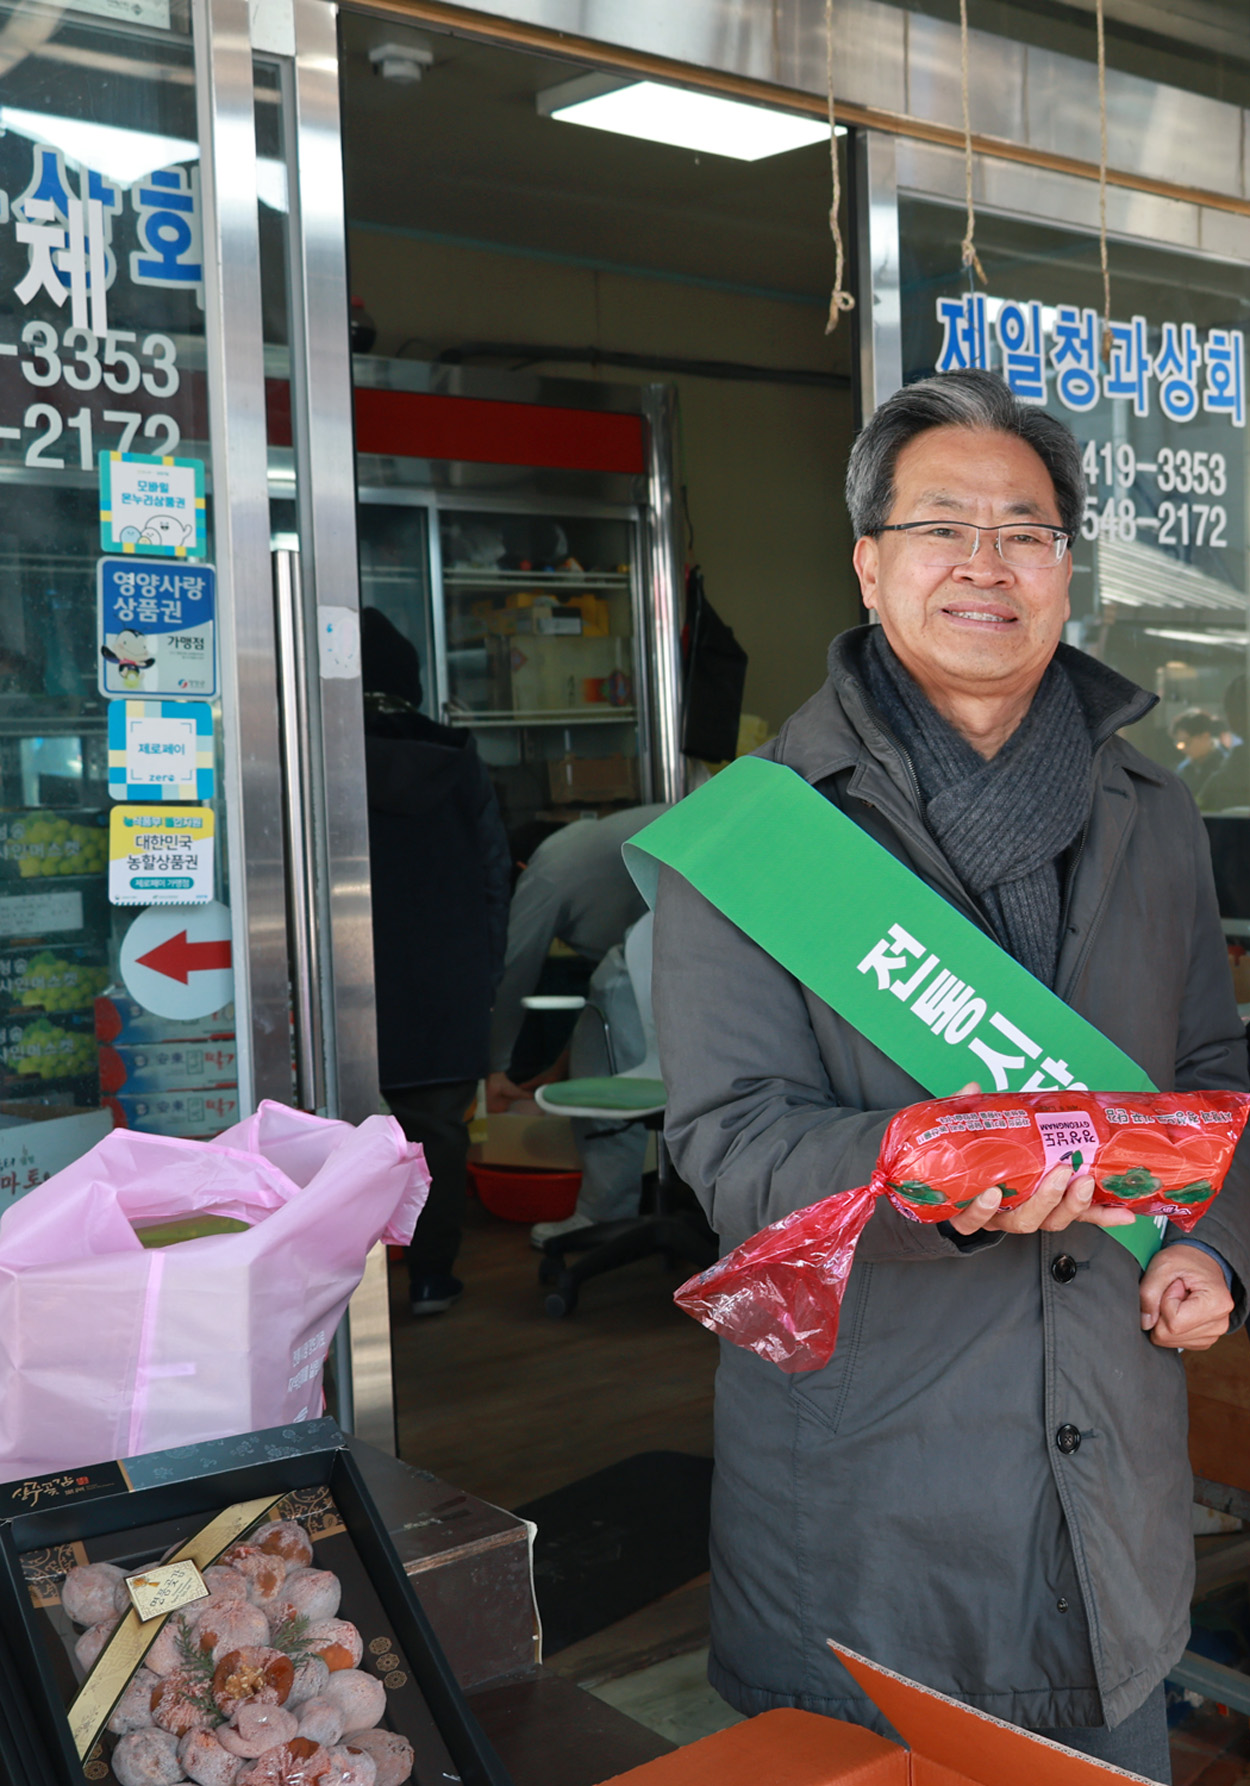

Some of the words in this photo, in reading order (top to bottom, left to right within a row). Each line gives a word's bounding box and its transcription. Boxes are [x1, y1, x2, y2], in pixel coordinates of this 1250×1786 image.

[935, 292, 1246, 428] 제일청과상회
[137, 479, 170, 494] 모바일
[121, 492, 186, 509] 온누리상품권
[112, 571, 207, 601] 영양사랑
[112, 597, 183, 624] 상품권
[167, 635, 205, 651] 가맹점
[137, 743, 185, 755] 제로페이
[135, 834, 193, 851] 대한민국
[126, 854, 199, 871] 농할상품권
[1105, 1108, 1129, 1125] 단감
[1039, 1120, 1091, 1131] GYEONGNAM
[1043, 1129, 1097, 1147] 경상남도
